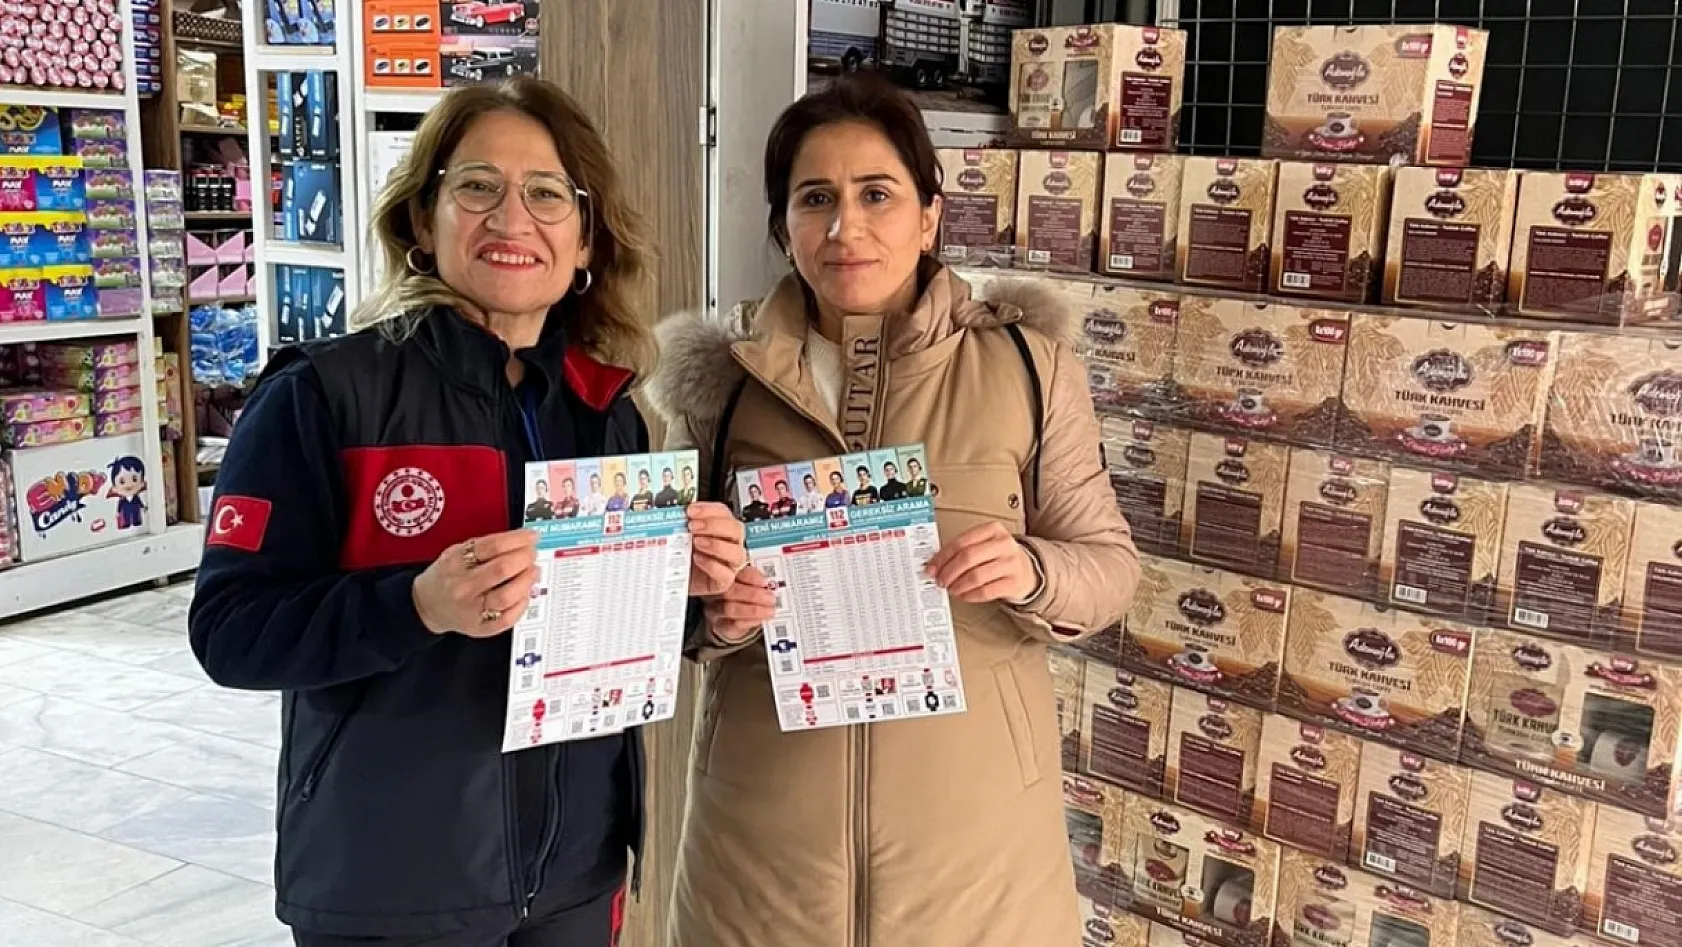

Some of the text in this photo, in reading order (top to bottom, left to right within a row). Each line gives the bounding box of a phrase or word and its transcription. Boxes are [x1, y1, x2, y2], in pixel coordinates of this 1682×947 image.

[1395, 389, 1427, 402] TÜRK
[1429, 394, 1486, 411] KAHVESİ
[897, 498, 930, 512] ARAMA
[608, 514, 620, 524] 112
[829, 509, 845, 521] 112
[771, 516, 825, 532] NUMARAMIZ
[1165, 619, 1190, 634] TÜRK
[1329, 660, 1412, 691] TÜRK KAHVESİ
[1515, 758, 1549, 776] TÜRK
[1550, 767, 1606, 791] KAHVESİ
